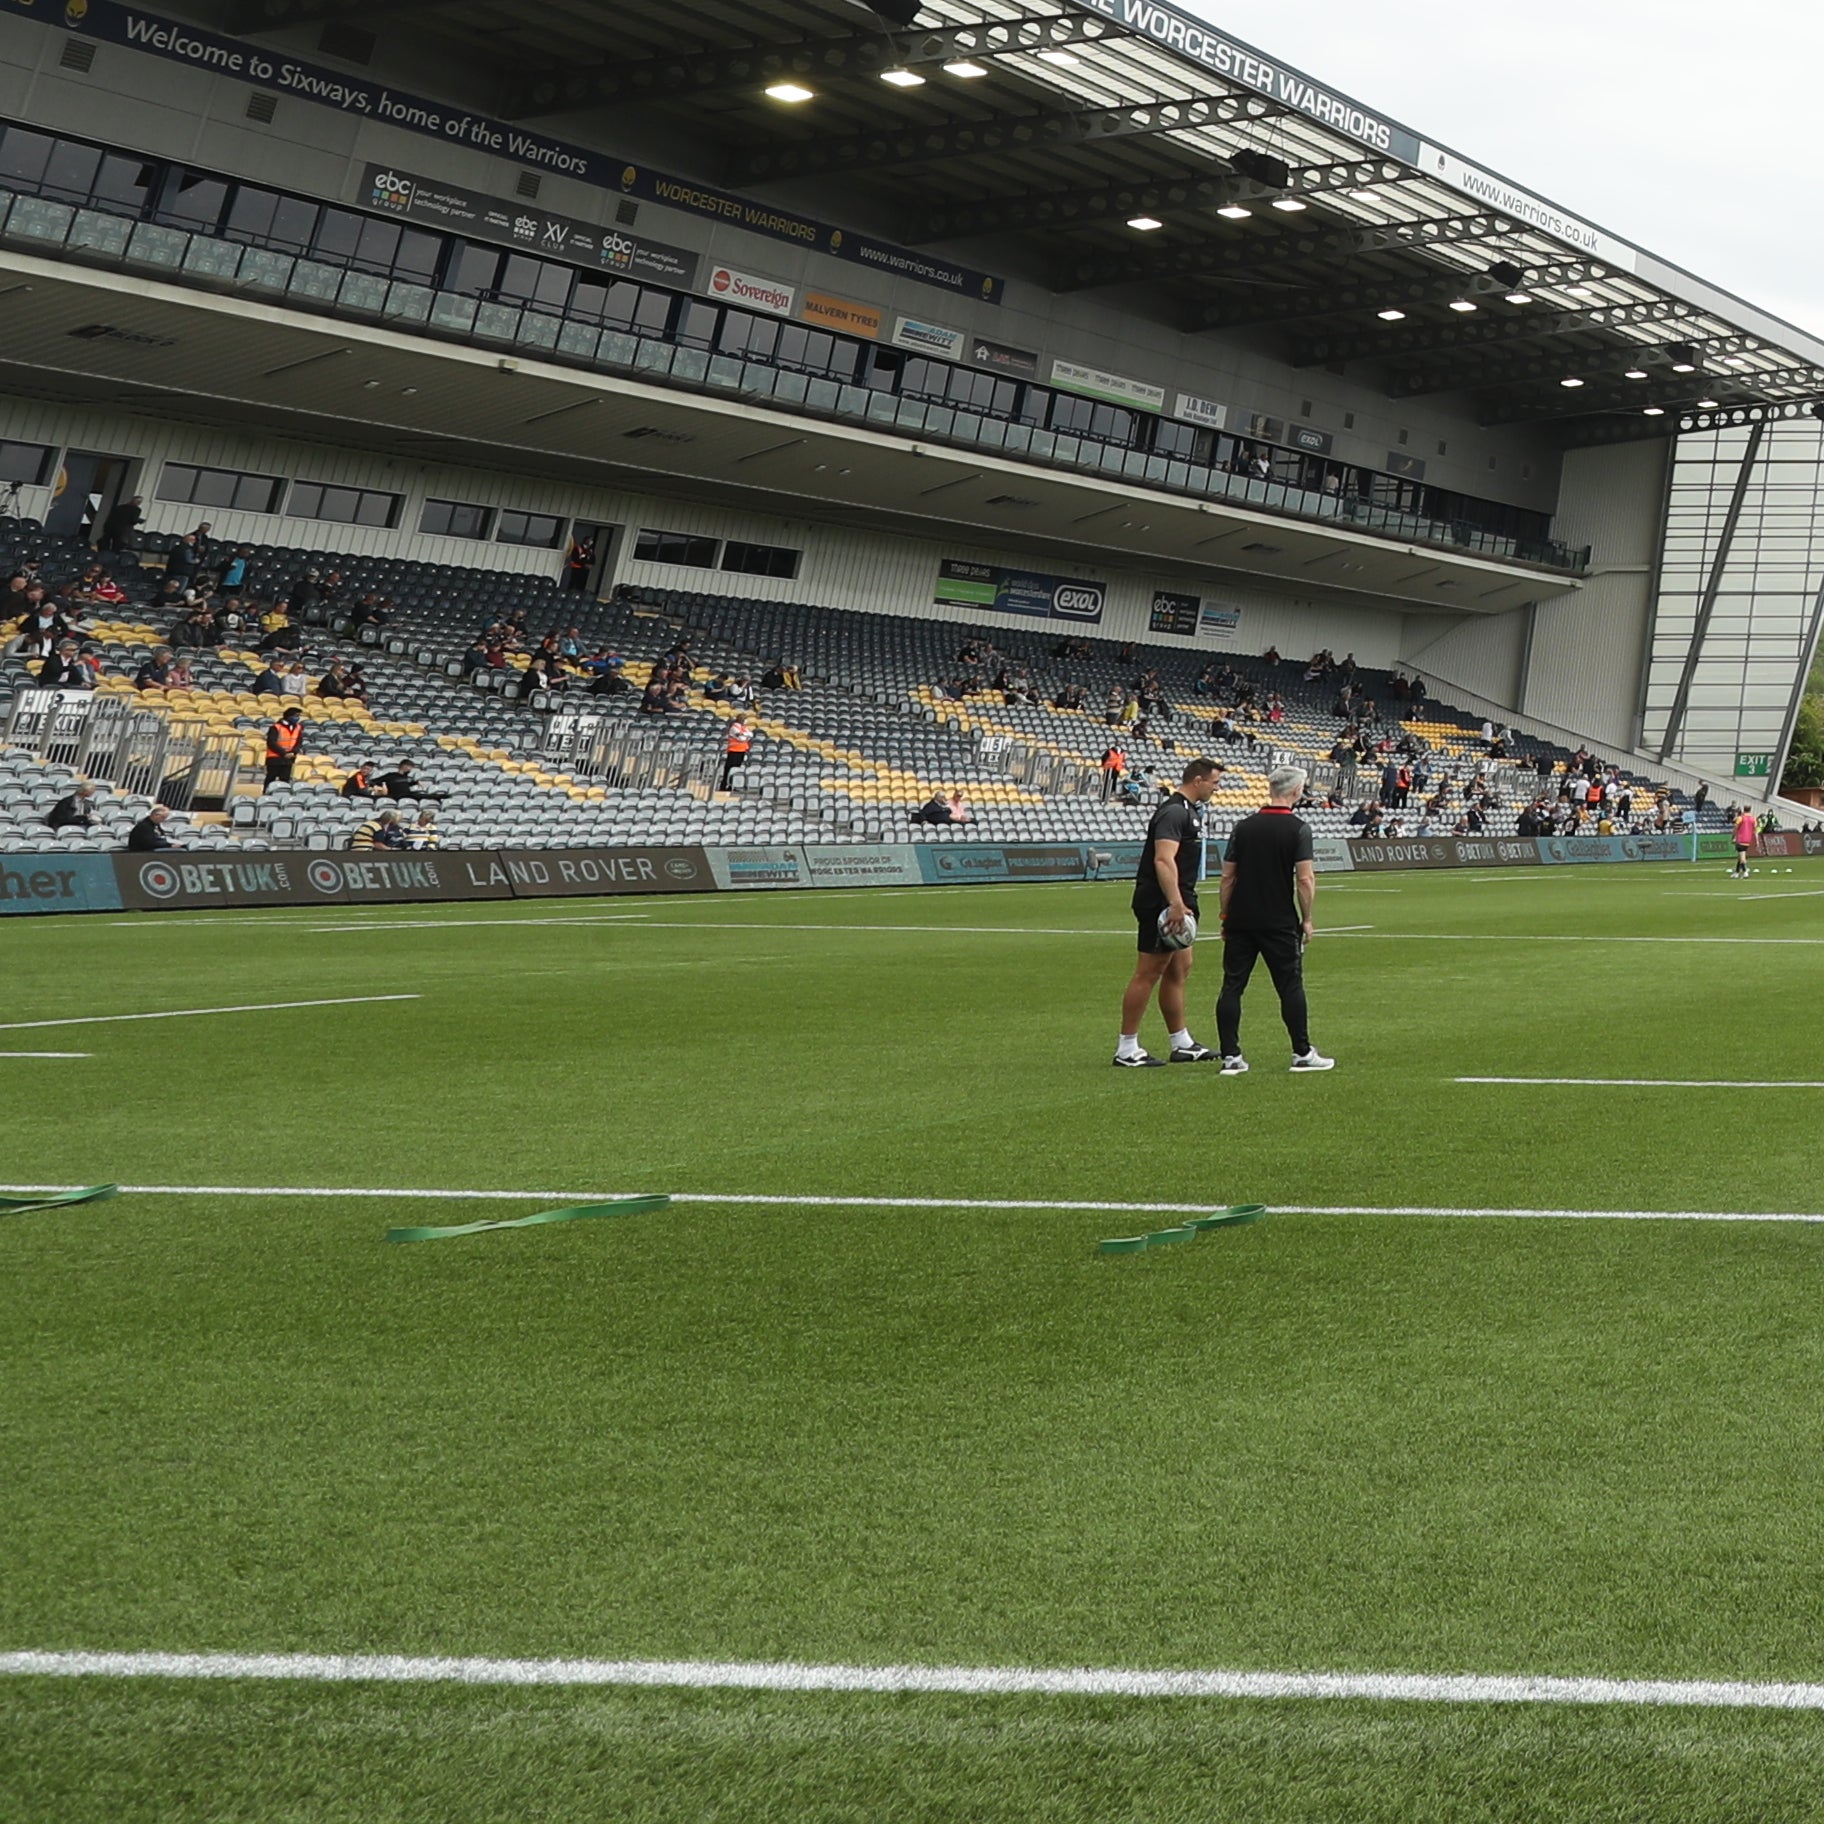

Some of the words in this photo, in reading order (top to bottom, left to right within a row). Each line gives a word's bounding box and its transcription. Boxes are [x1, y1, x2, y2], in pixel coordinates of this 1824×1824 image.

[126, 15, 243, 71] Welcome
[249, 55, 273, 79] to
[278, 64, 371, 113] Sixways,
[378, 91, 440, 130] home
[445, 117, 472, 138] of
[471, 122, 502, 149] the
[507, 132, 588, 175] Warriors
[1278, 73, 1391, 150] WARRIORS
[374, 170, 411, 195] ebc
[371, 197, 404, 212] group
[655, 180, 742, 220] WORCESTER
[744, 207, 817, 241] WARRIORS
[1461, 170, 1600, 252] www.warriors.co.uk
[543, 220, 569, 243] XV
[602, 232, 633, 254] ebc
[859, 245, 964, 288] www.warriors.co.uk
[731, 277, 790, 310] Sovereign
[805, 300, 848, 322] MALVERN
[850, 312, 878, 328] TYRES
[928, 327, 958, 341] ADAM
[1154, 595, 1176, 614] ebc
[1739, 754, 1765, 765] EXIT
[1749, 765, 1756, 774] 3
[1352, 846, 1385, 863] LAND
[1386, 844, 1429, 862] ROVER
[180, 863, 277, 894] BETUK
[274, 862, 292, 891] .com
[341, 861, 430, 889] BETUK
[424, 861, 441, 888] .com
[465, 859, 550, 887] LAND
[563, 857, 657, 883] ROVER
